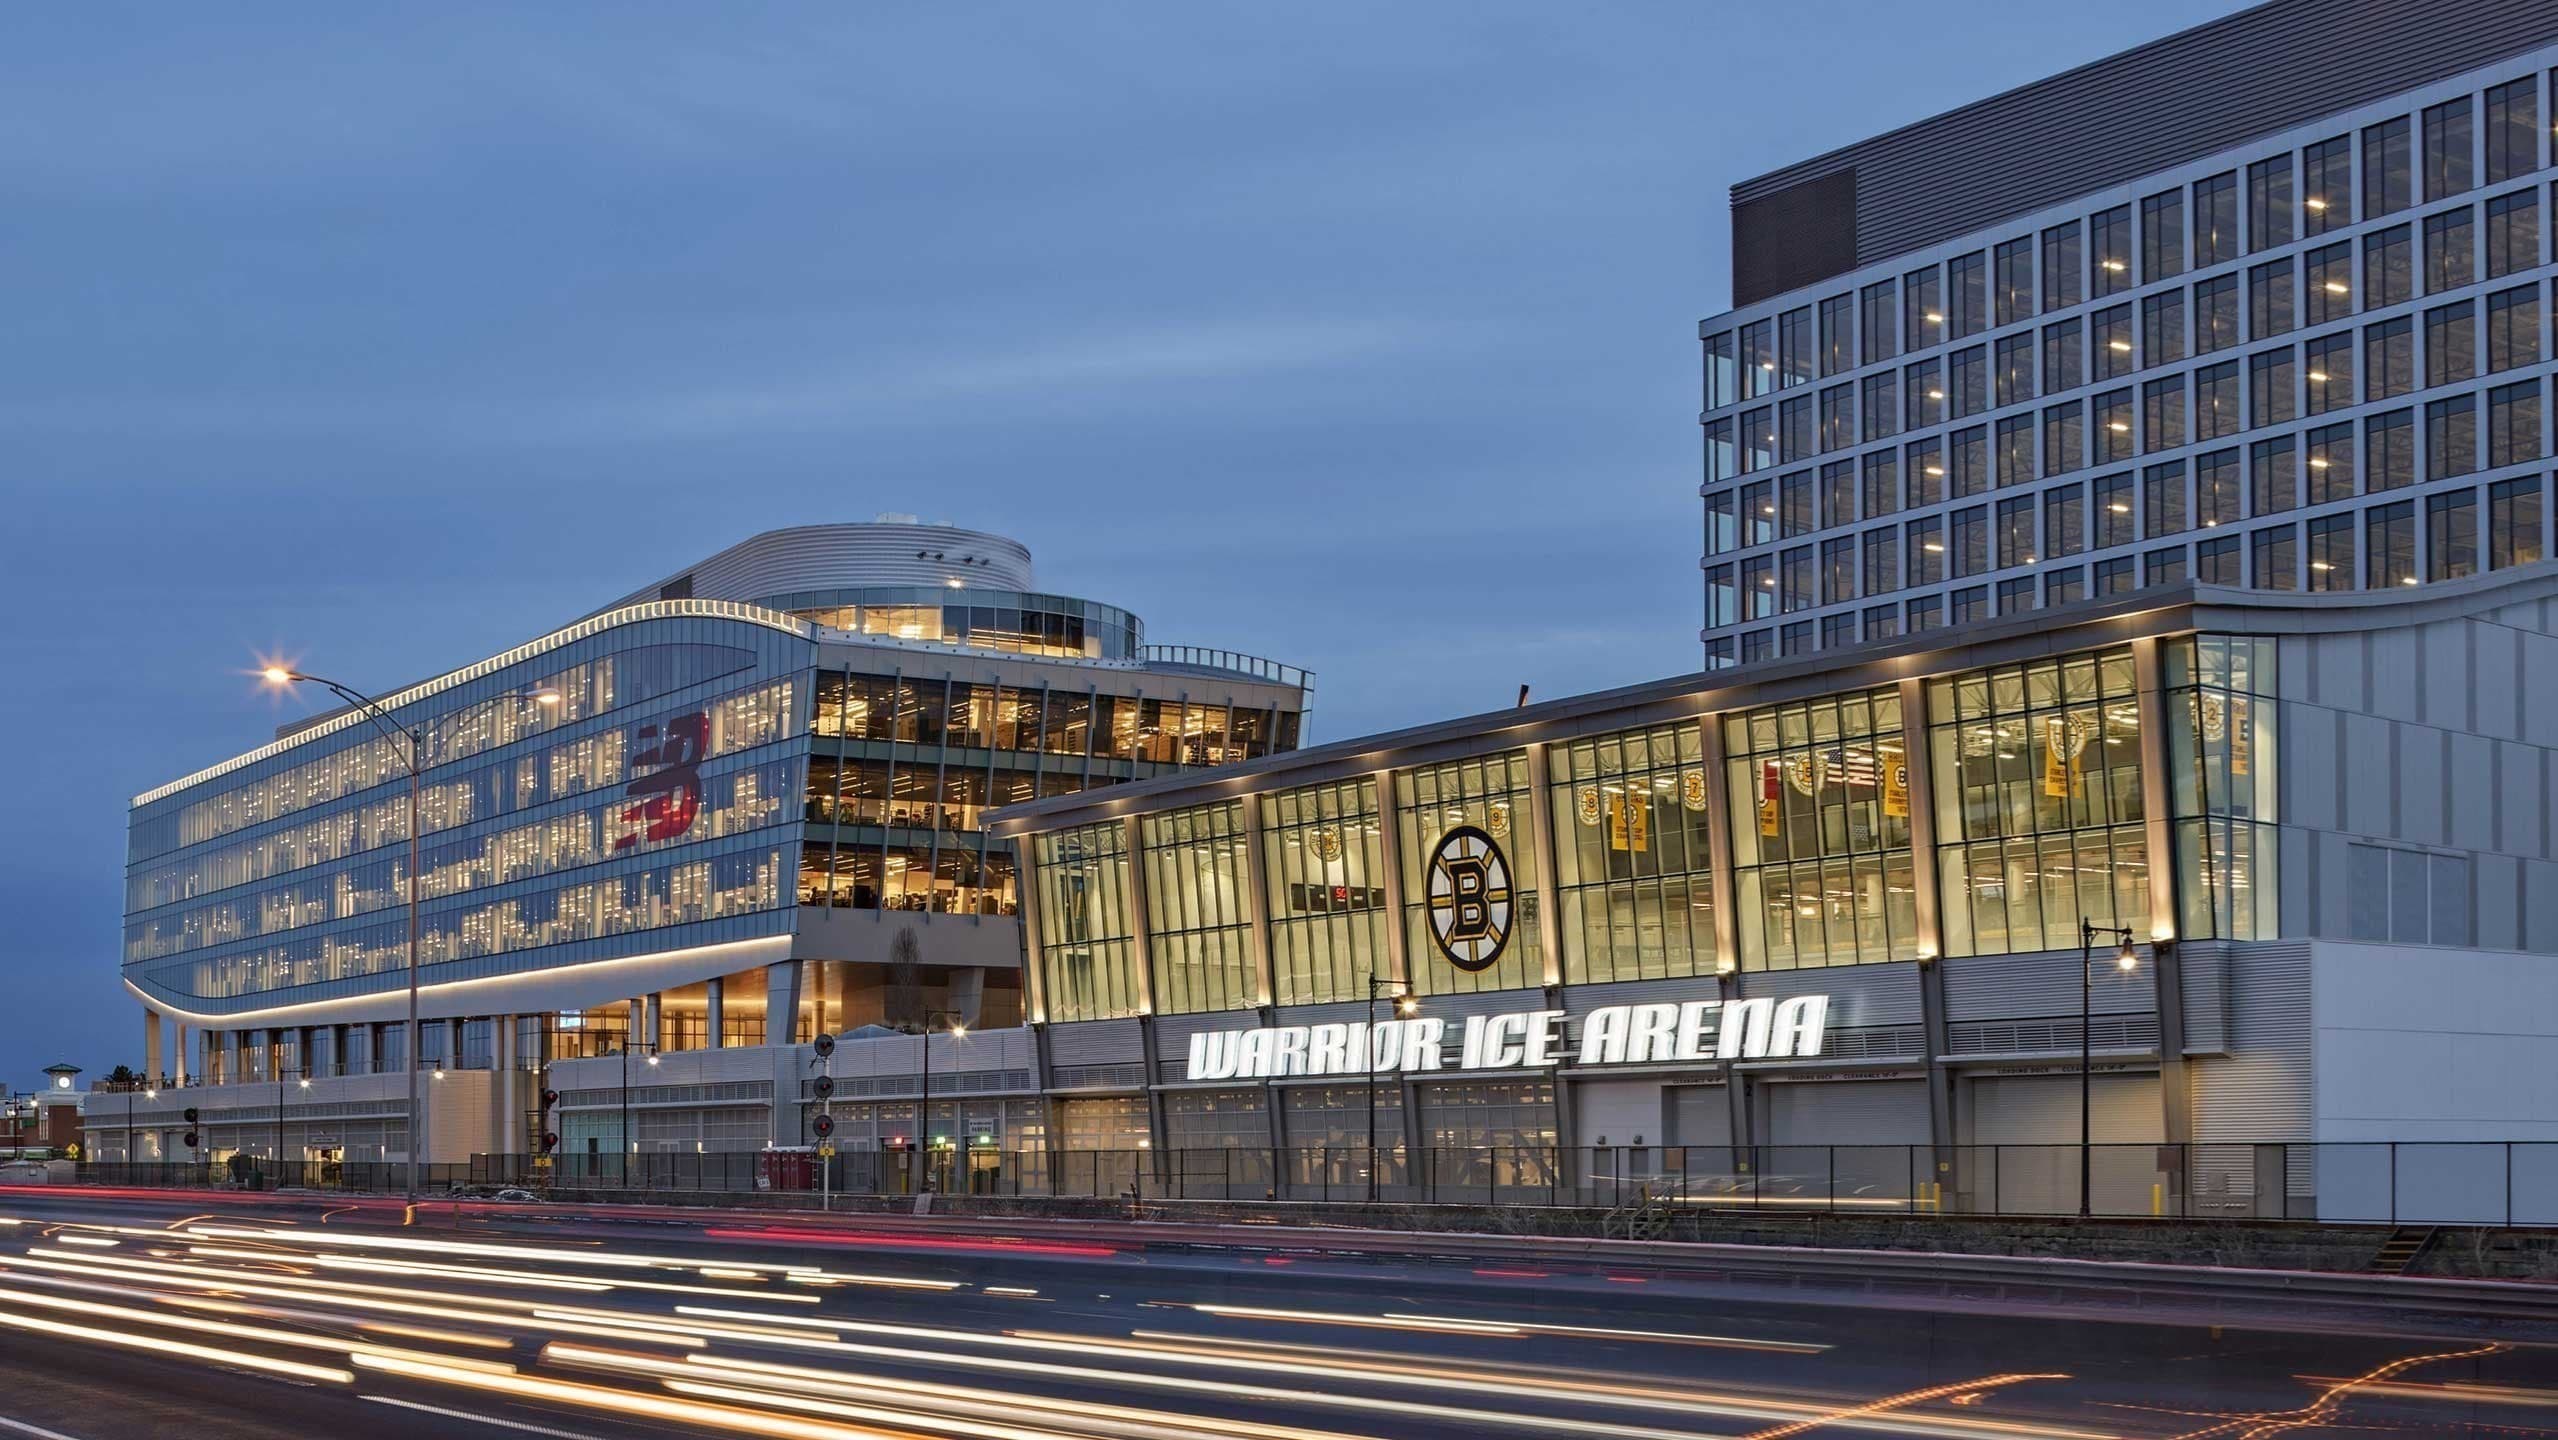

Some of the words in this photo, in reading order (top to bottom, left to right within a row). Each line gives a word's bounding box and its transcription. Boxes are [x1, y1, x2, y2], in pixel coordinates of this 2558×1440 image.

[1447, 856, 1491, 941] B
[1187, 1018, 1444, 1080] WARRIOR
[1461, 1010, 1565, 1069] ICE
[1577, 995, 1829, 1064] ARENA
